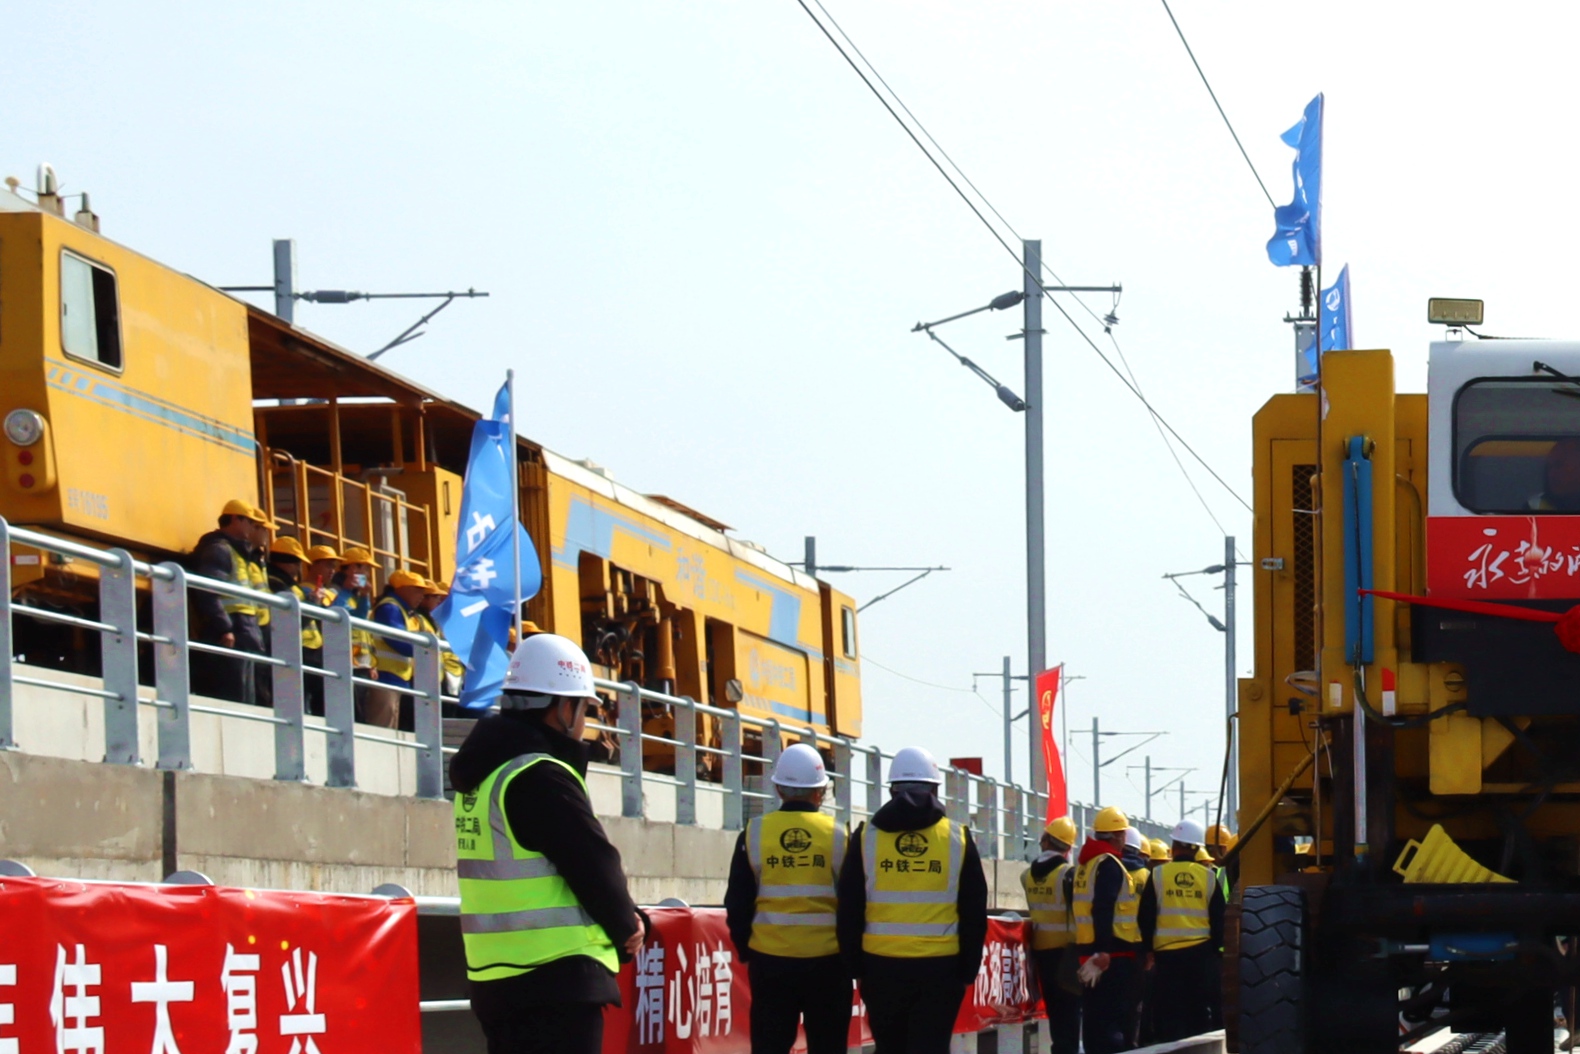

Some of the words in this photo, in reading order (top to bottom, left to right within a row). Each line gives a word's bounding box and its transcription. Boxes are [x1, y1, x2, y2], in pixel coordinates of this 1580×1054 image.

[766, 855, 826, 869] 中铁二局
[880, 858, 942, 875] 中铁二局
